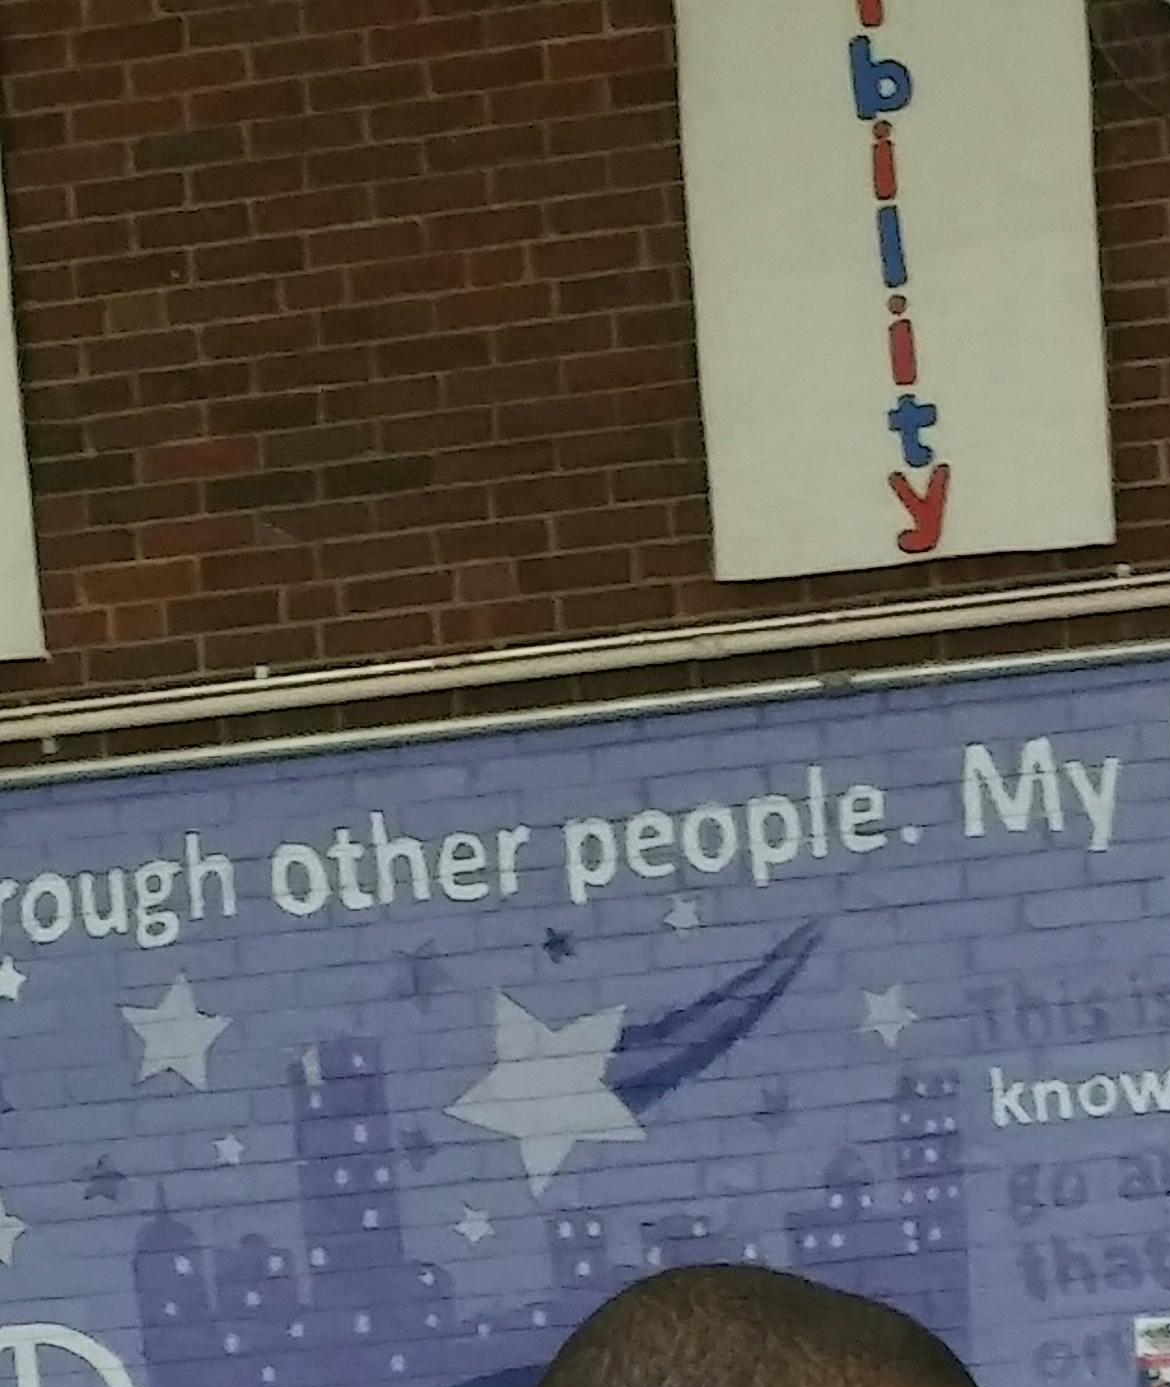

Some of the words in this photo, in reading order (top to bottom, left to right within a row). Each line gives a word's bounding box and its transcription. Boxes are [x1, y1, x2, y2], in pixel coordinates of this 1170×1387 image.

[269, 811, 531, 916] other
[564, 764, 922, 905] people.
[961, 736, 1122, 853] My
